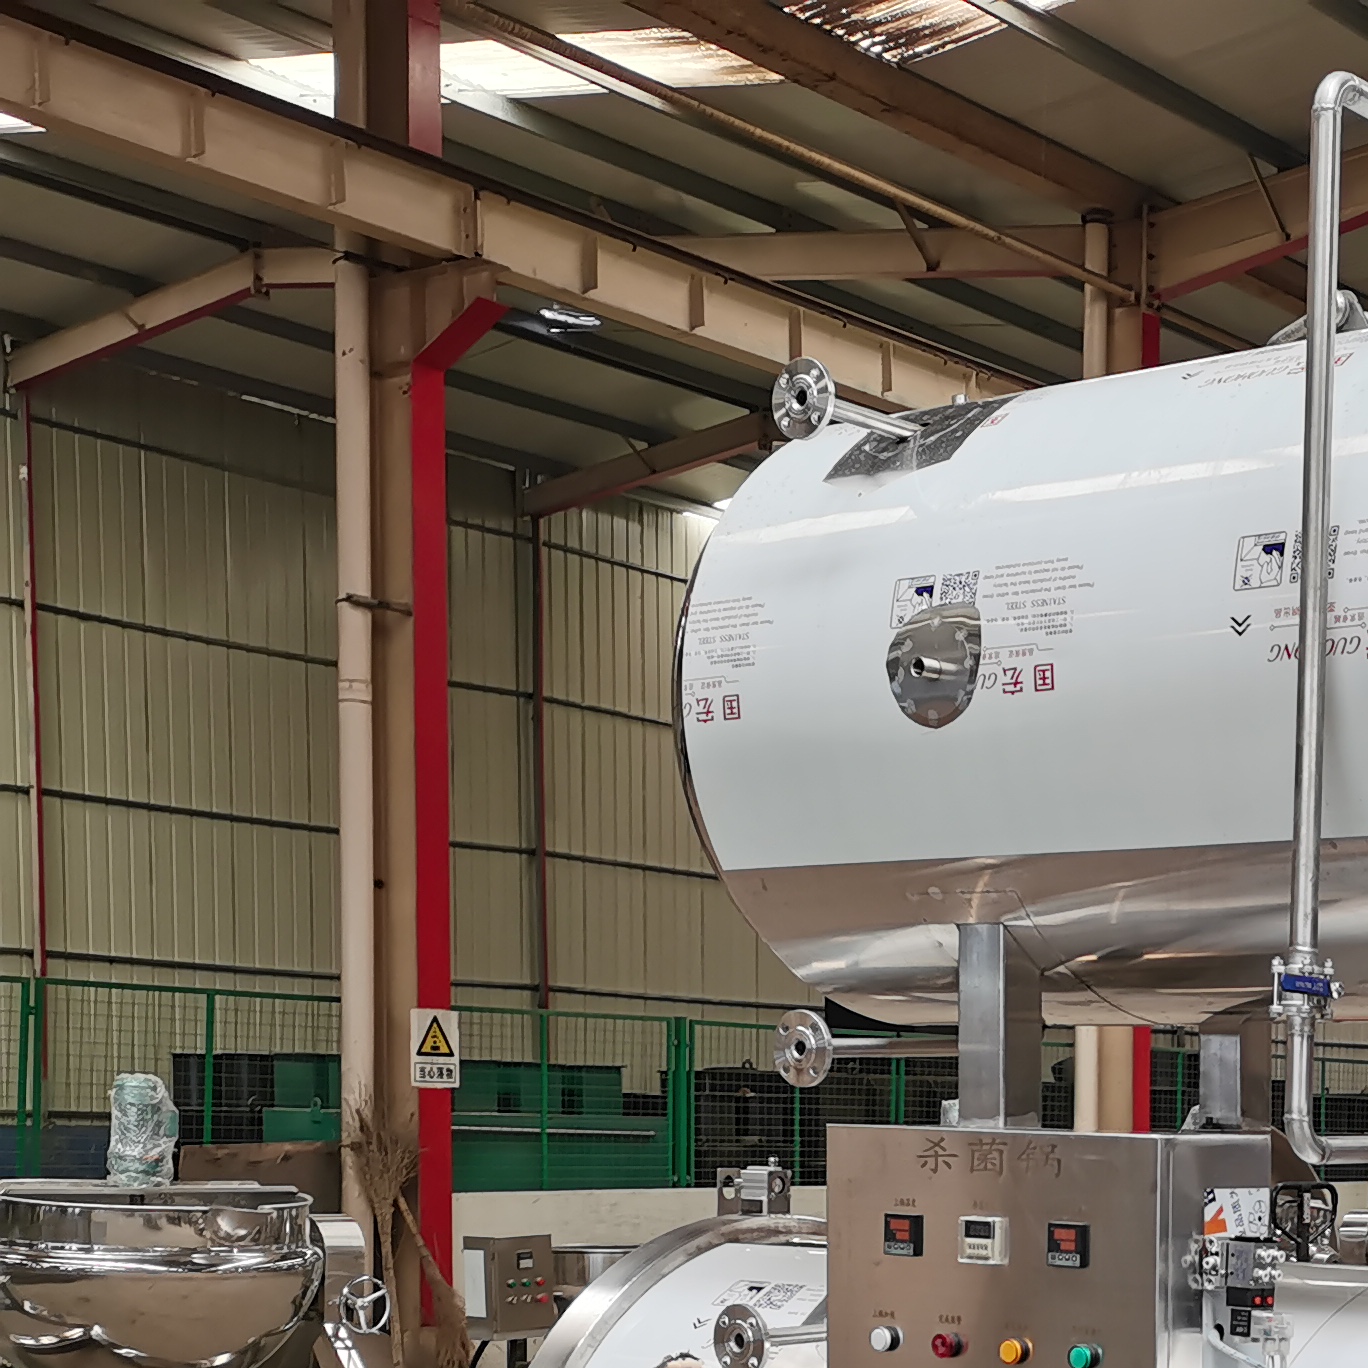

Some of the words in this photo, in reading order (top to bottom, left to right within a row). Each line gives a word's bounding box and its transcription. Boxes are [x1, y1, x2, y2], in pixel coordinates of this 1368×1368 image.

[1002, 663, 1054, 695] 国宏
[695, 694, 741, 723] 国宏
[917, 1137, 1062, 1178] 杀菌锅
